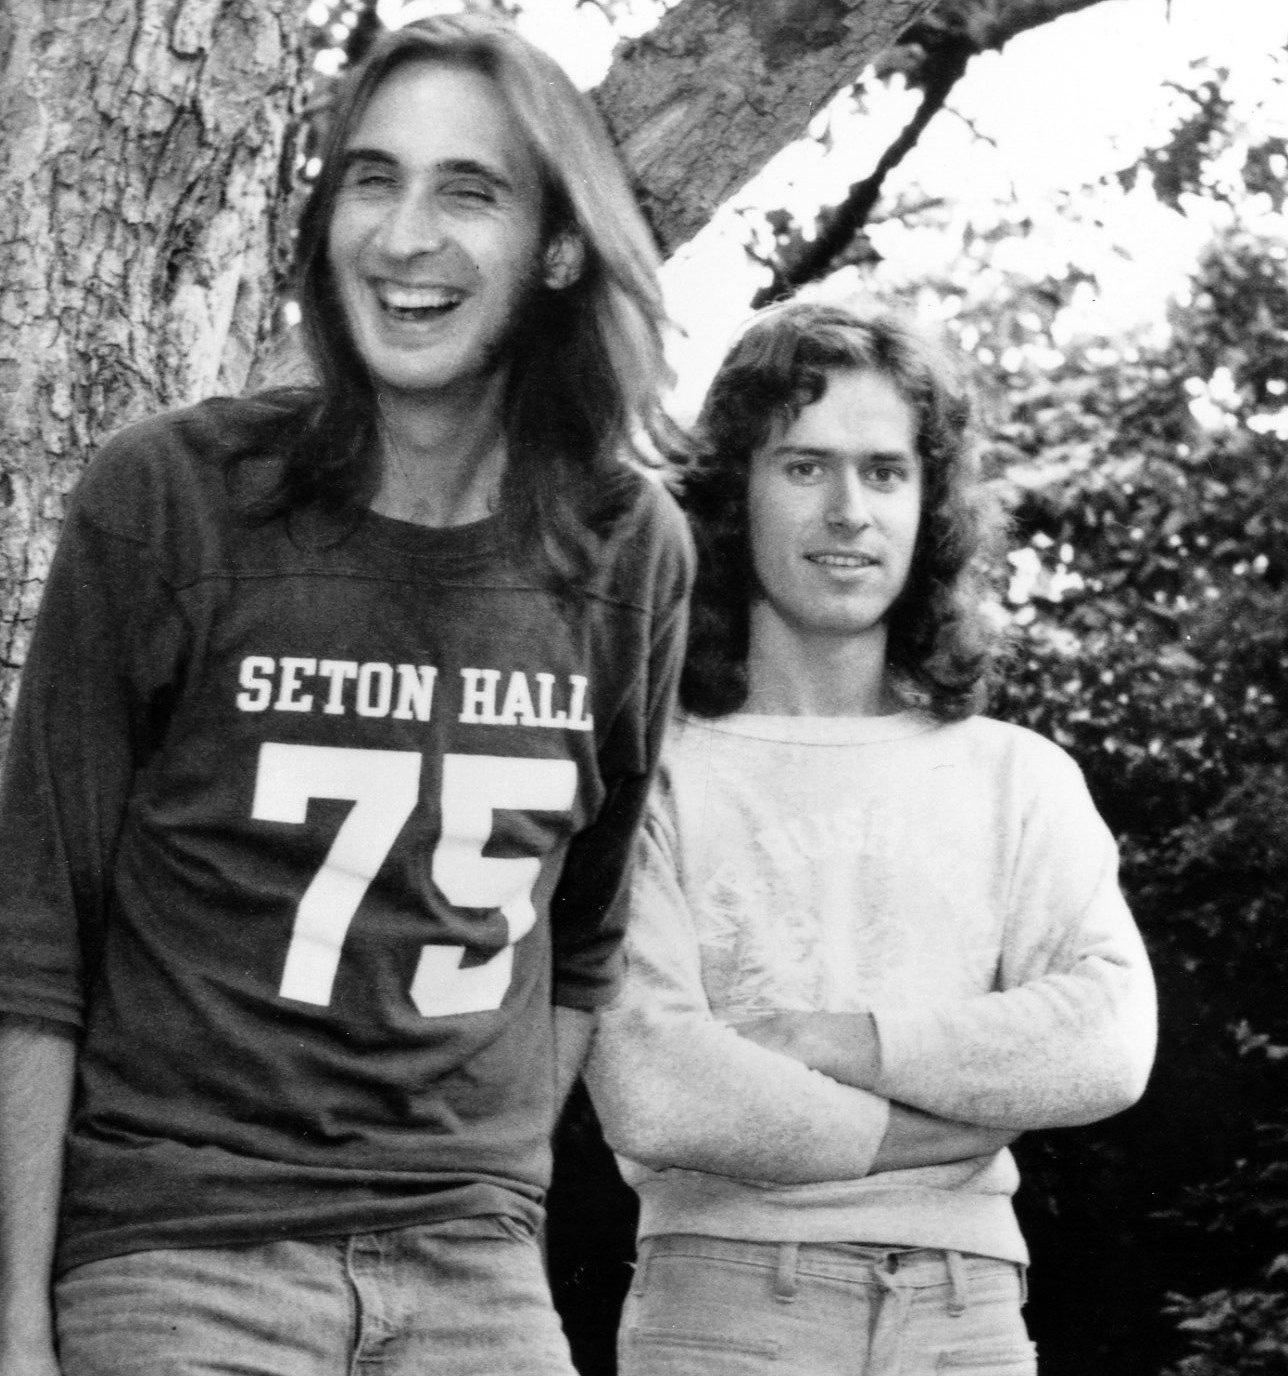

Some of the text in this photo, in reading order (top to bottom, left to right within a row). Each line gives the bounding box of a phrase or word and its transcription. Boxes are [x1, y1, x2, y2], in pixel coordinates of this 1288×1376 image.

[236, 655, 594, 732] SETON HALL
[251, 742, 578, 1017] 75
